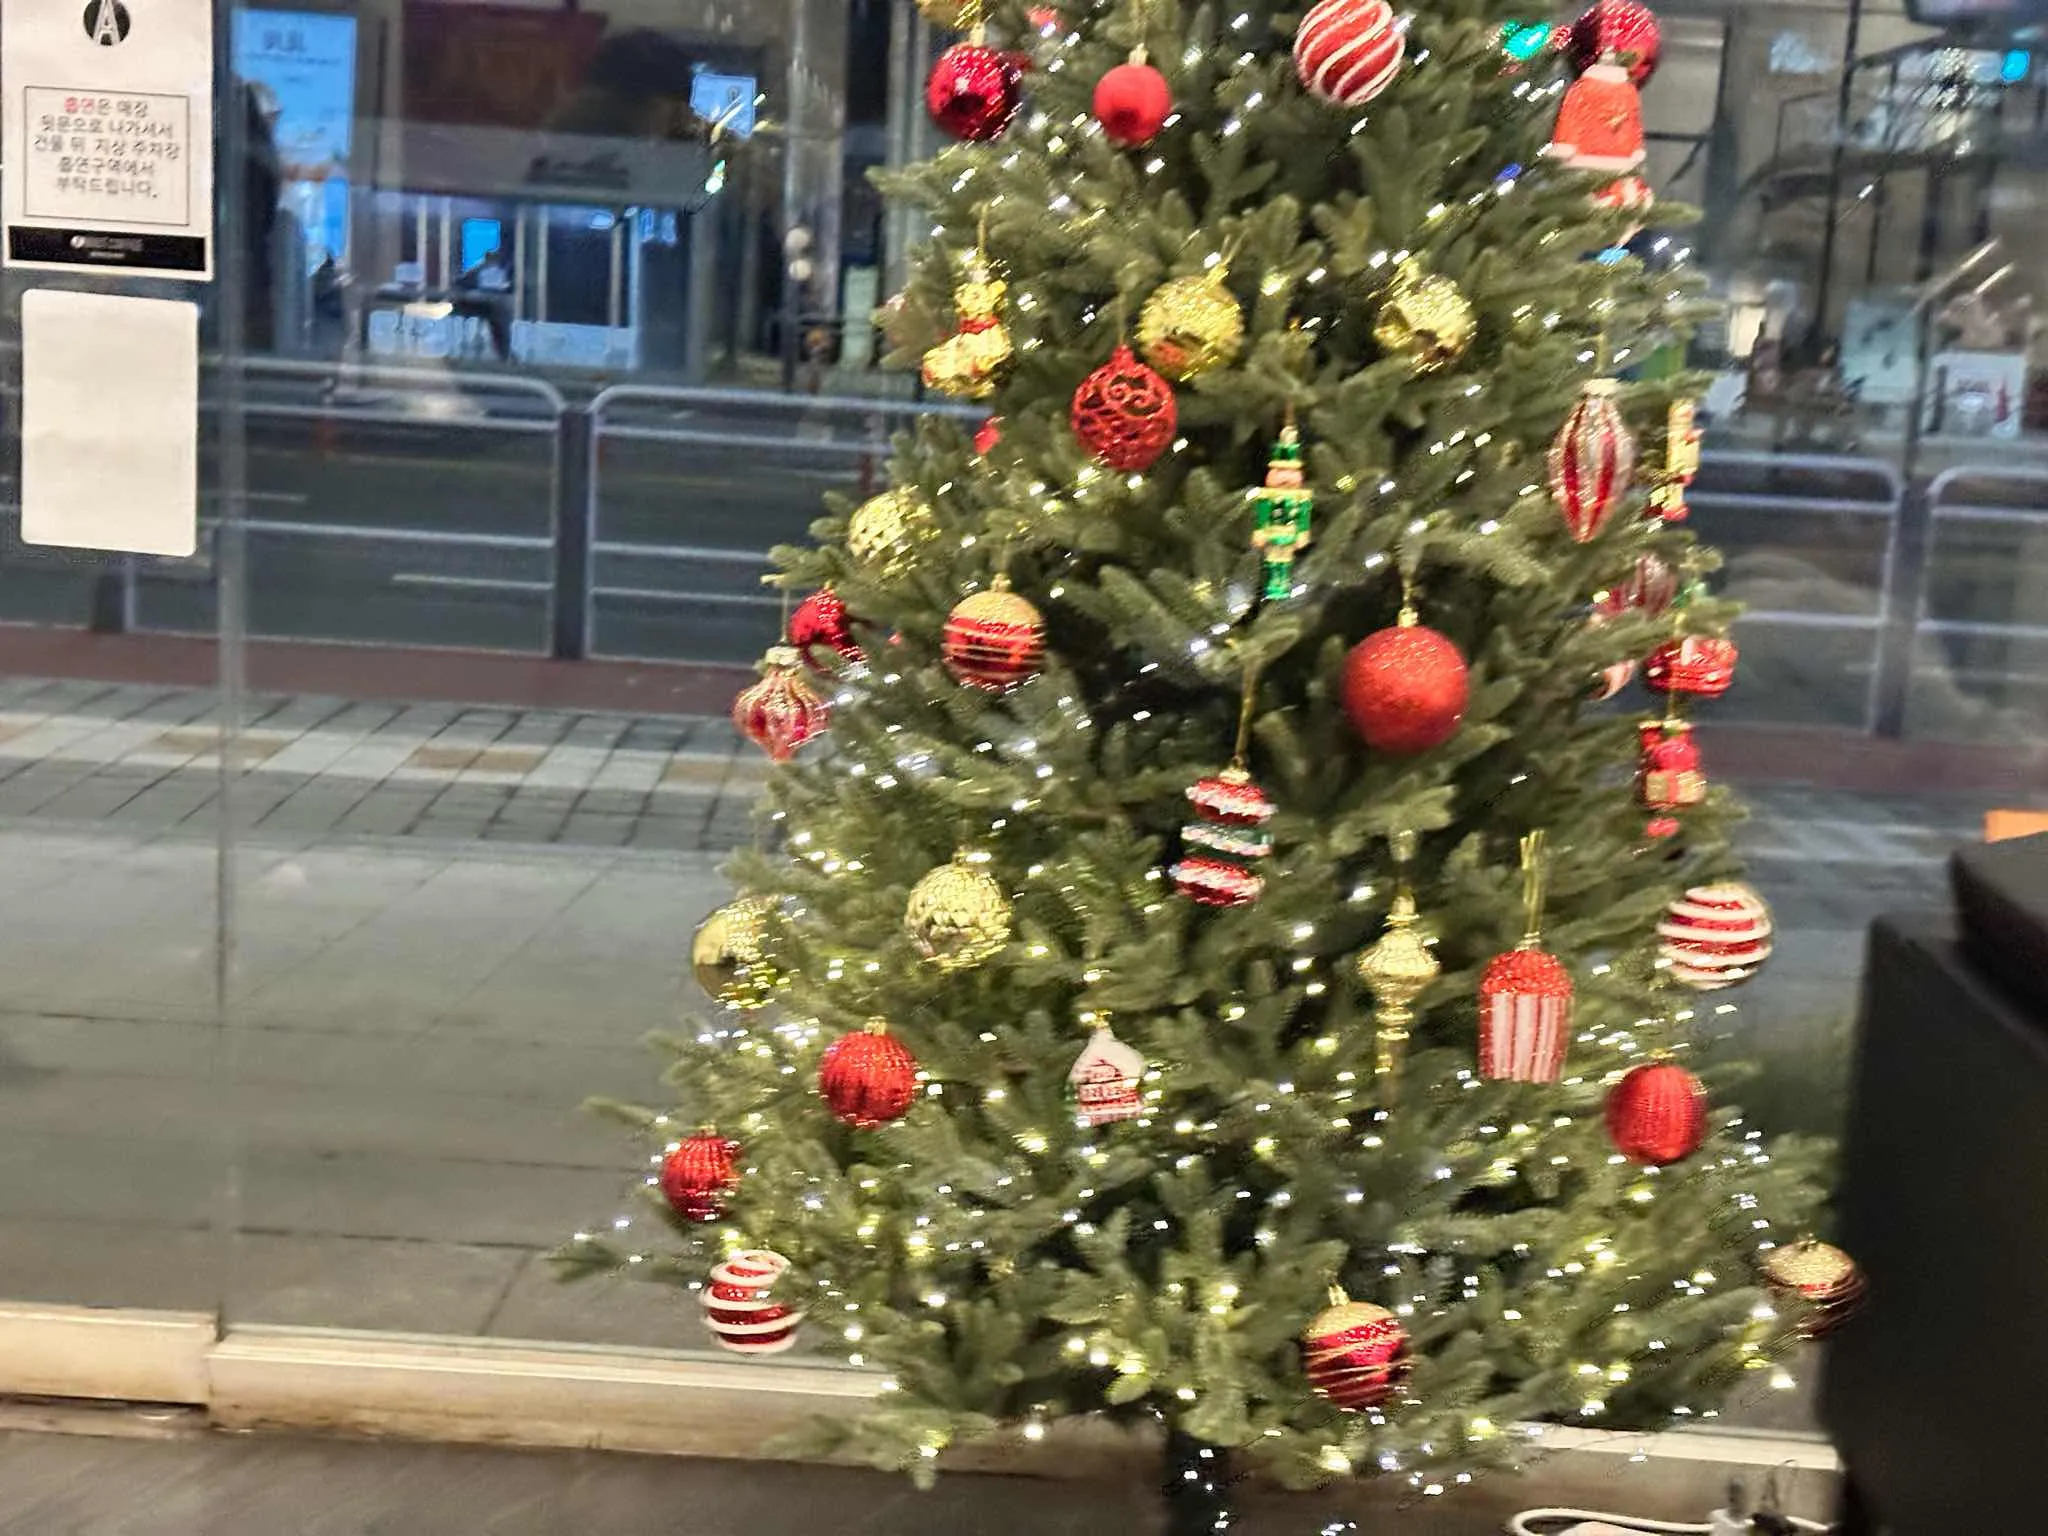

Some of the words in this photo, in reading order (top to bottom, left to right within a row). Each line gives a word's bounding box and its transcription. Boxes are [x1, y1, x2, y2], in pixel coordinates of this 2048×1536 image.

[64, 97, 111, 116] 흡연은
[116, 101, 148, 118] 매장
[34, 134, 62, 152] 건물
[96, 139, 126, 156] 지상
[132, 141, 180, 160] 주차장
[59, 156, 155, 176] 흡연구역에서
[57, 176, 158, 198] 부탁드립니다.
